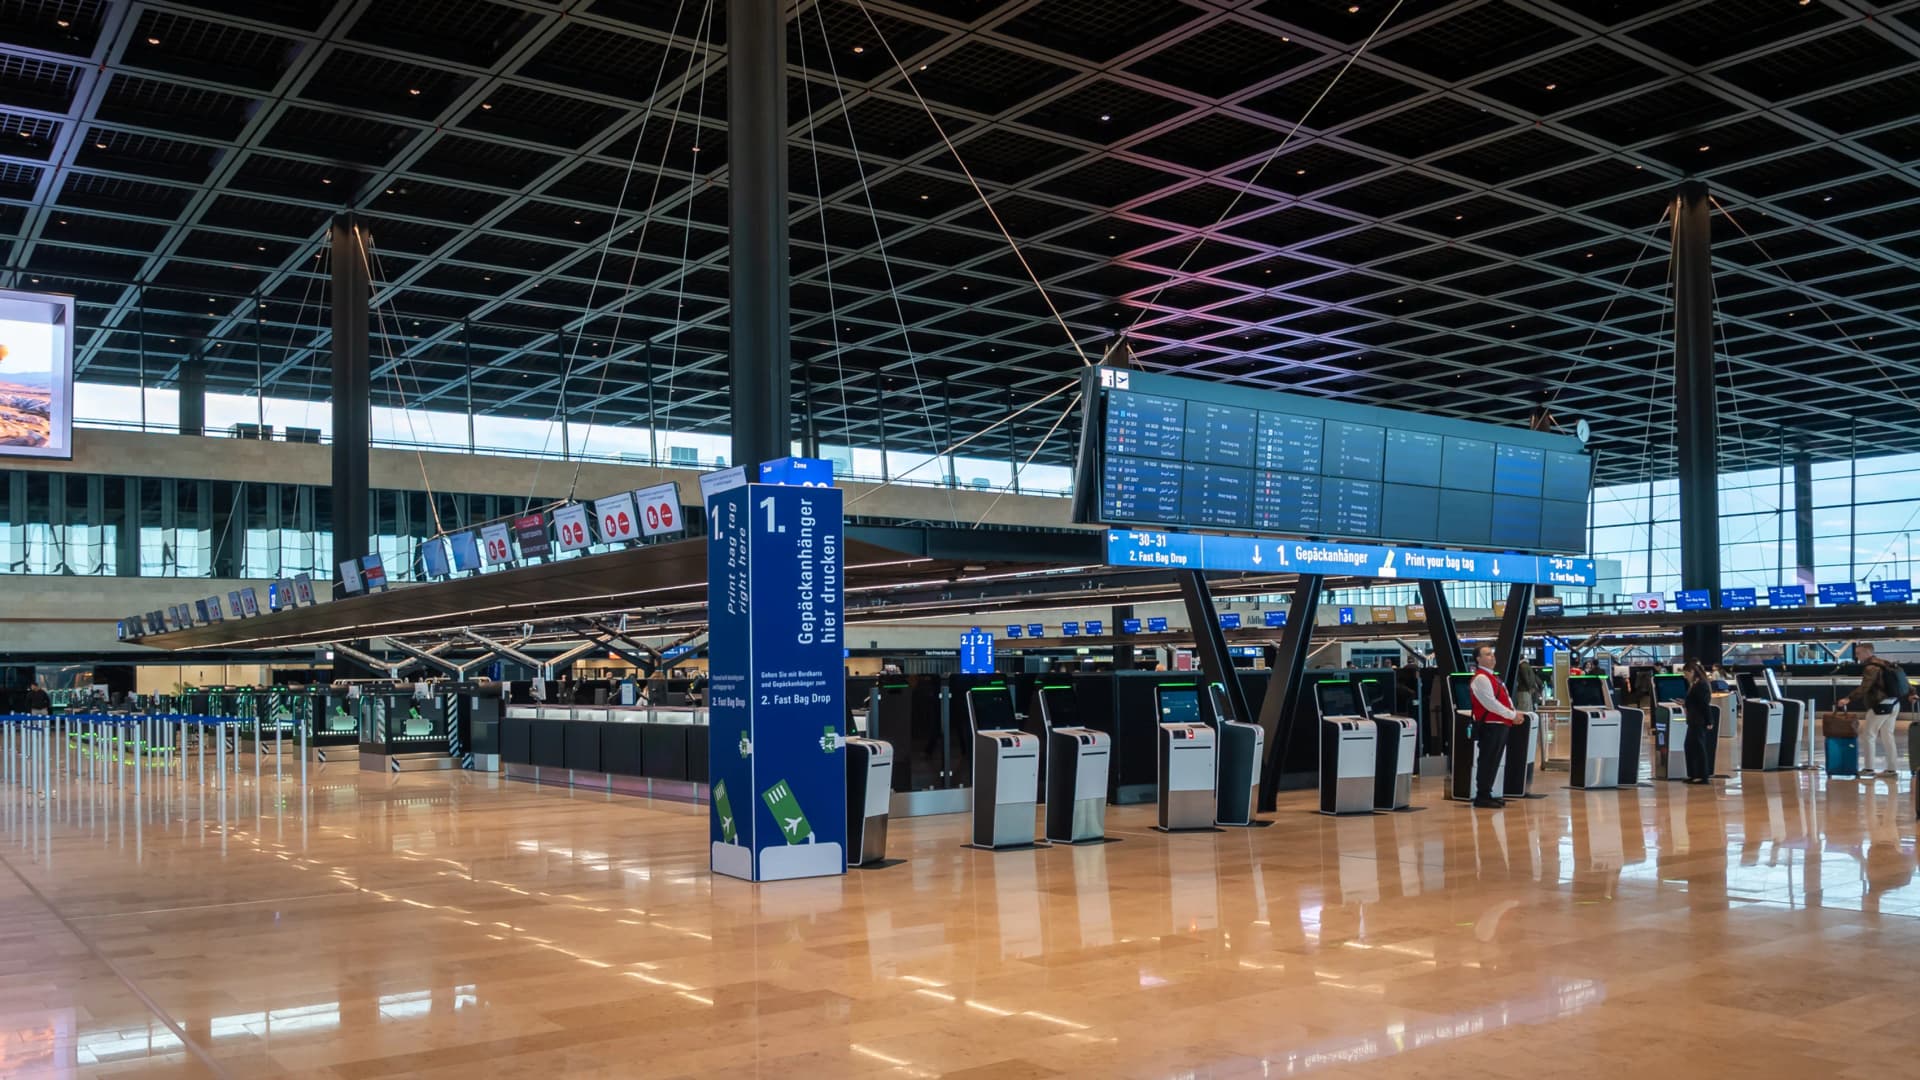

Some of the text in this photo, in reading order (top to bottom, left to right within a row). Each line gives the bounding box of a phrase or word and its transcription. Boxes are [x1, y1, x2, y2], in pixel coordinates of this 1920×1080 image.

[793, 461, 807, 469] Zone
[711, 505, 723, 540] 1.
[760, 497, 786, 533] 1.
[727, 502, 737, 615] Print bag tag
[1129, 550, 1187, 565] 2. Fast Bag Drop
[1277, 544, 1368, 566] 1. Gepäckanhänger
[1405, 552, 1474, 572] Print your bag tag
[797, 498, 816, 644] Gepäckanhänger
[1550, 572, 1585, 584] 2. Fast Bag Drop
[739, 572, 749, 614] right
[820, 535, 836, 643] hier drucken
[1344, 614, 1351, 622] 34
[962, 636, 968, 645] 2.
[977, 634, 984, 644] 2.
[772, 680, 814, 688] Gepäckanhänger
[712, 697, 717, 706] 2.
[761, 693, 831, 705] 2. Fast Bag Drop
